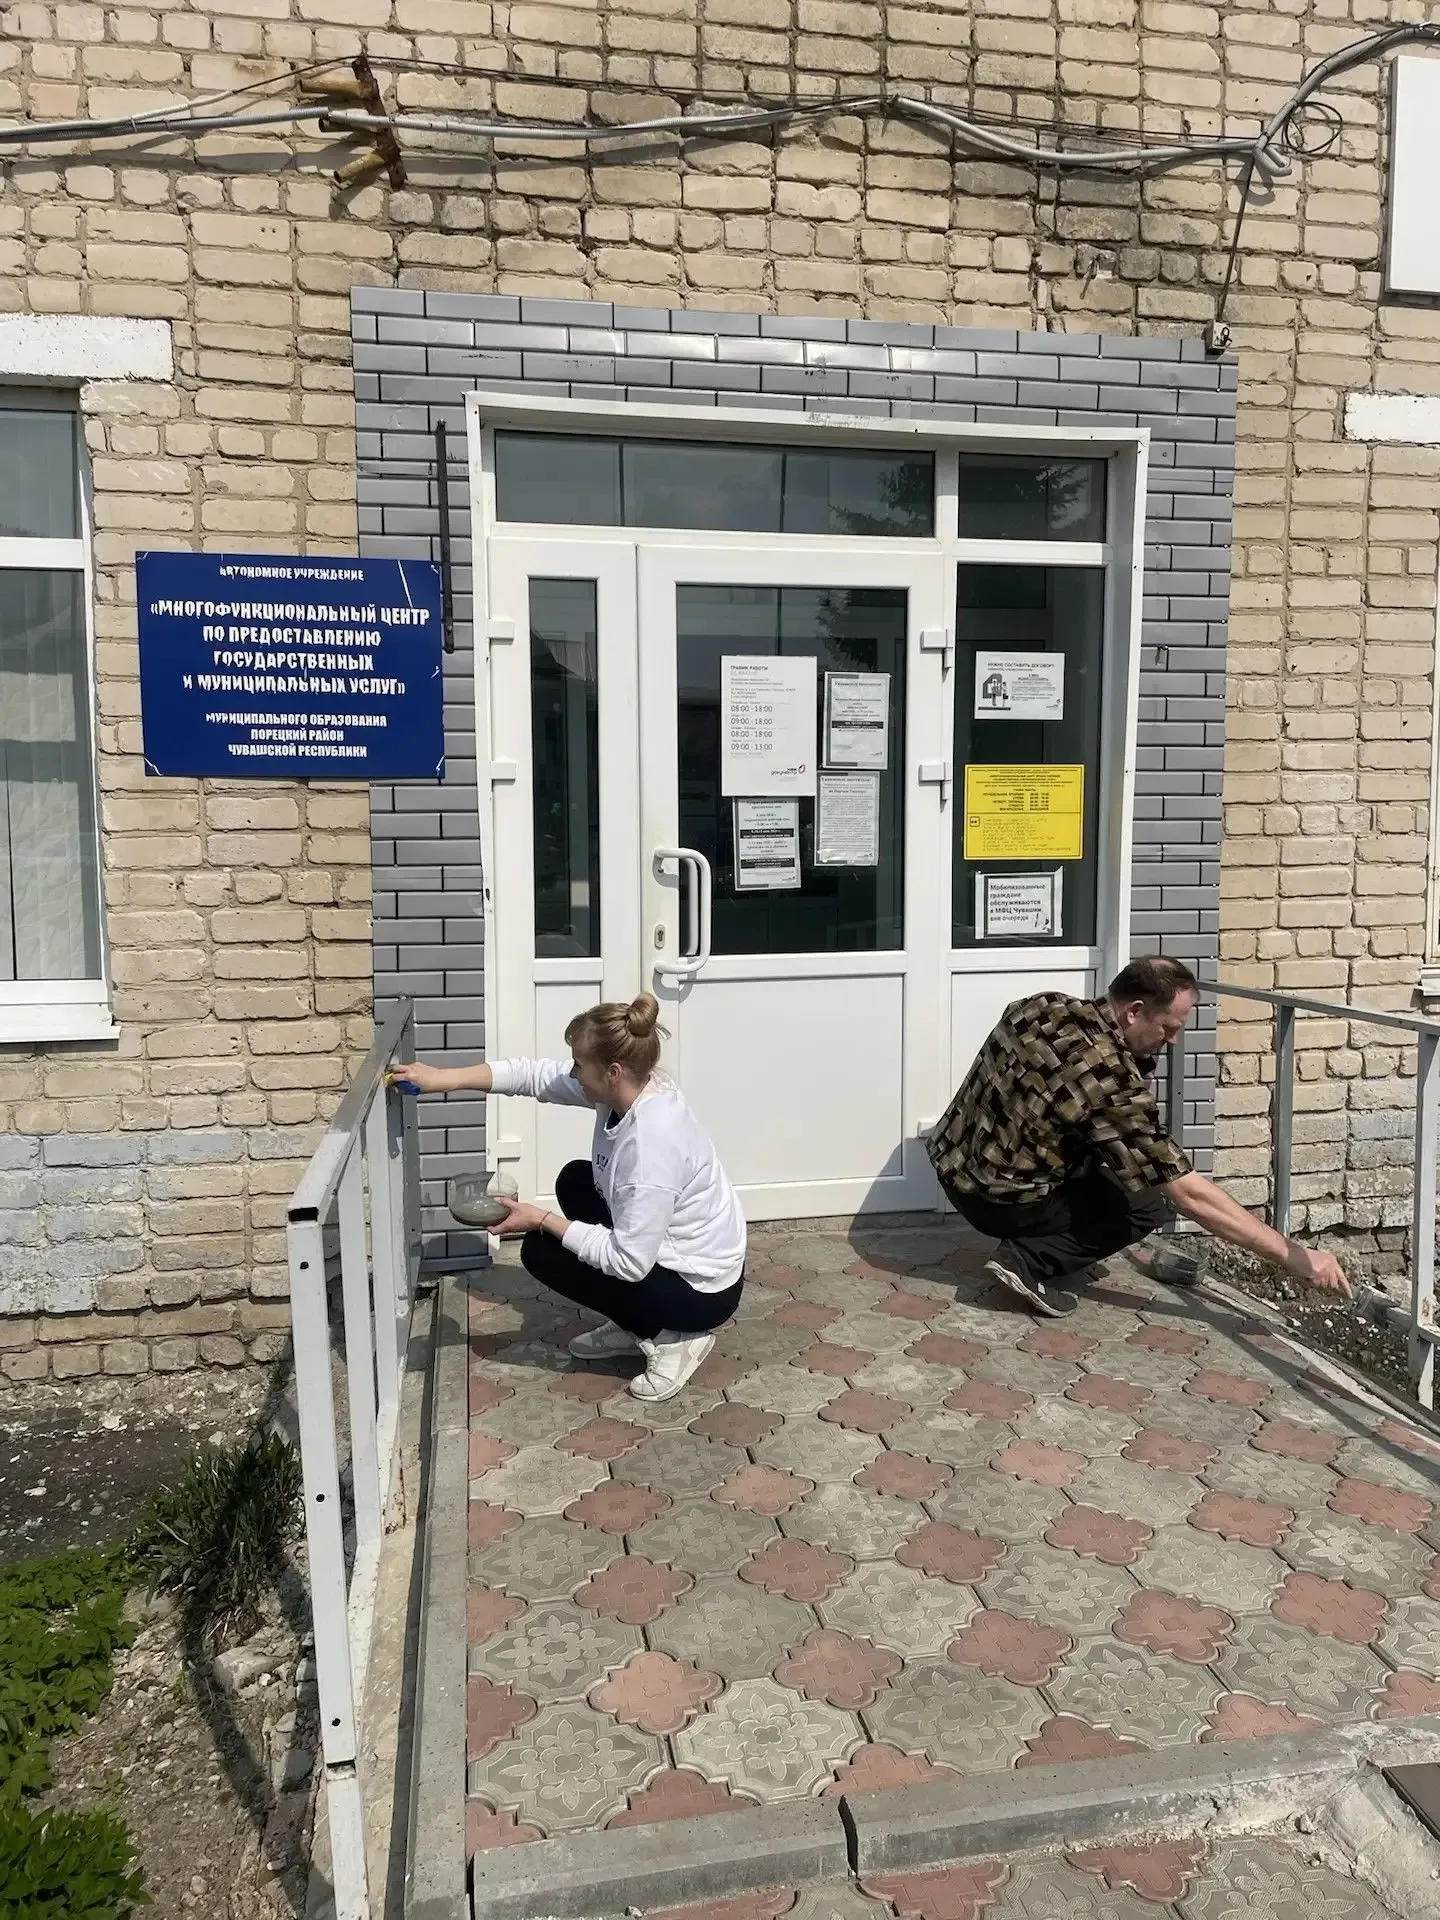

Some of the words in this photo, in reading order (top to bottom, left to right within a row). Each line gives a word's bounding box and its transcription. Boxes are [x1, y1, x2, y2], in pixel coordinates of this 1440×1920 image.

[293, 568, 364, 581] УЧРЕЖДЕНИЕ
[150, 600, 376, 623] «МНОГОФУНКЦИОНАЛЬНЫЙ
[380, 607, 430, 626] ЦЕНТР
[203, 625, 225, 642] ПО
[228, 626, 381, 646] ПРЕДОСТАВЛЕНИЮ
[213, 651, 374, 671] ГОСУДАРСТВЕННЫХ
[183, 674, 193, 690] И
[198, 675, 347, 694] МУНИЦИПАЛЬНЫХ
[349, 678, 405, 695] УСЛУГ»
[206, 713, 308, 726] МУНИЦИПАЛЬНОГО
[309, 714, 387, 727] ОБРАЗОВАНИЯ
[251, 727, 307, 742] ПОРЕЦКИЙ
[309, 727, 344, 742] РАЙОН
[228, 742, 297, 757] ЧУВАШСКОЙ
[298, 745, 368, 758] РЕСПУБЛИКИ
